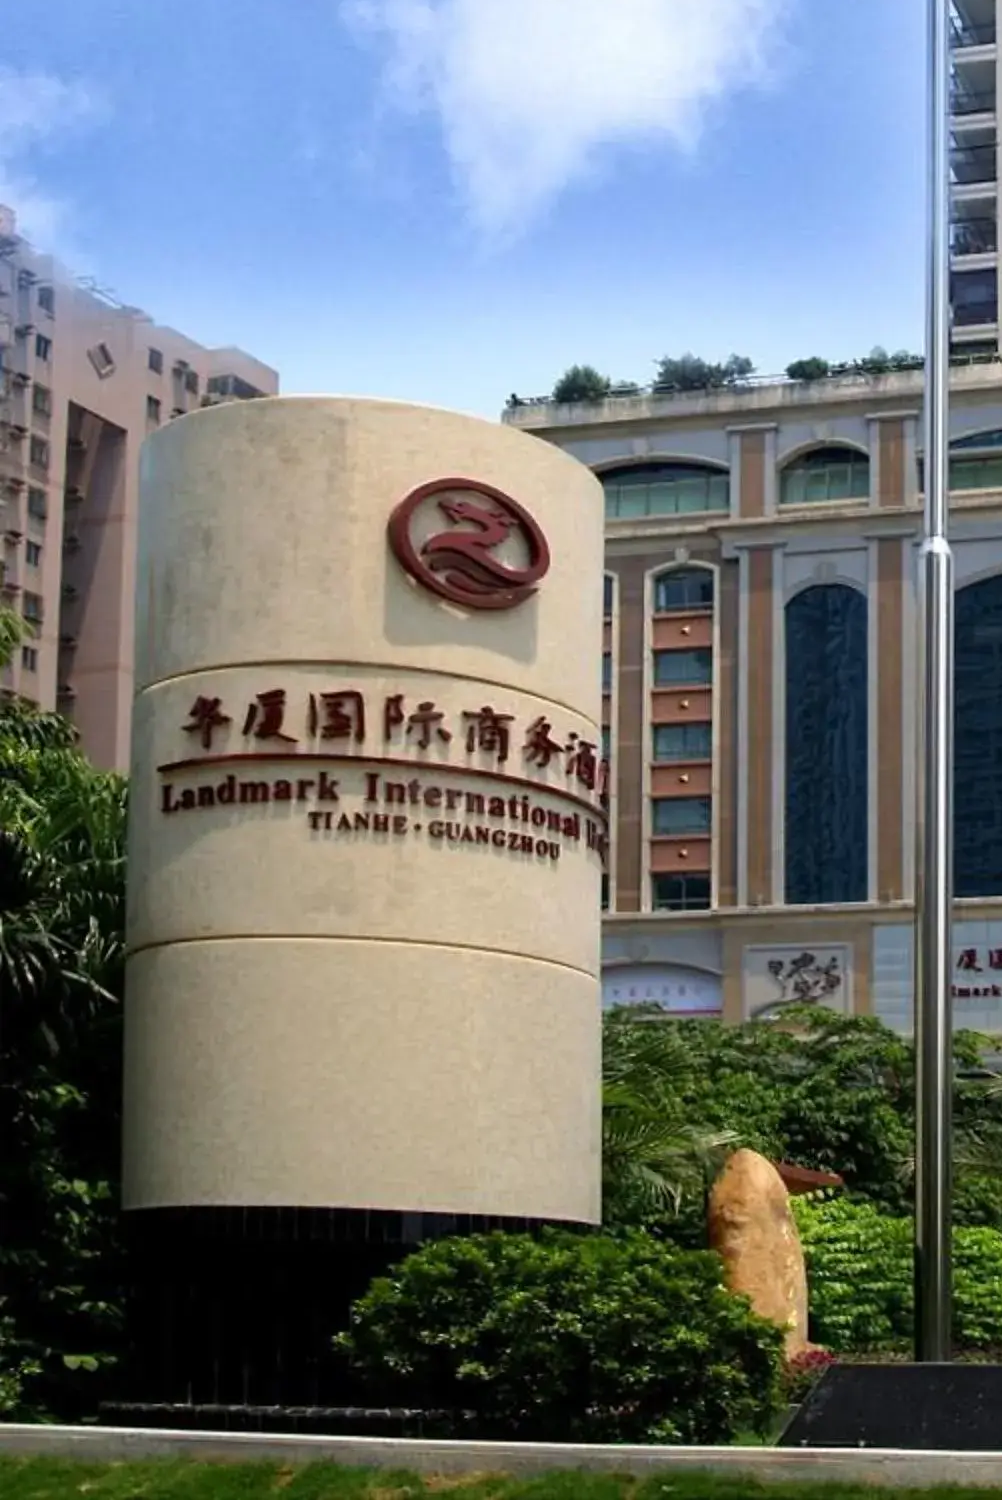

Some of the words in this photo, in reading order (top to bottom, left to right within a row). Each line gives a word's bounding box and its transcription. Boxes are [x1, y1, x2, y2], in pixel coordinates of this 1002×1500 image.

[180, 688, 609, 812] 华厦国际商务酒
[161, 771, 340, 814] Landmark
[364, 772, 580, 841] International
[308, 811, 408, 836] TIANHE
[428, 820, 561, 861] GUANGZHOU
